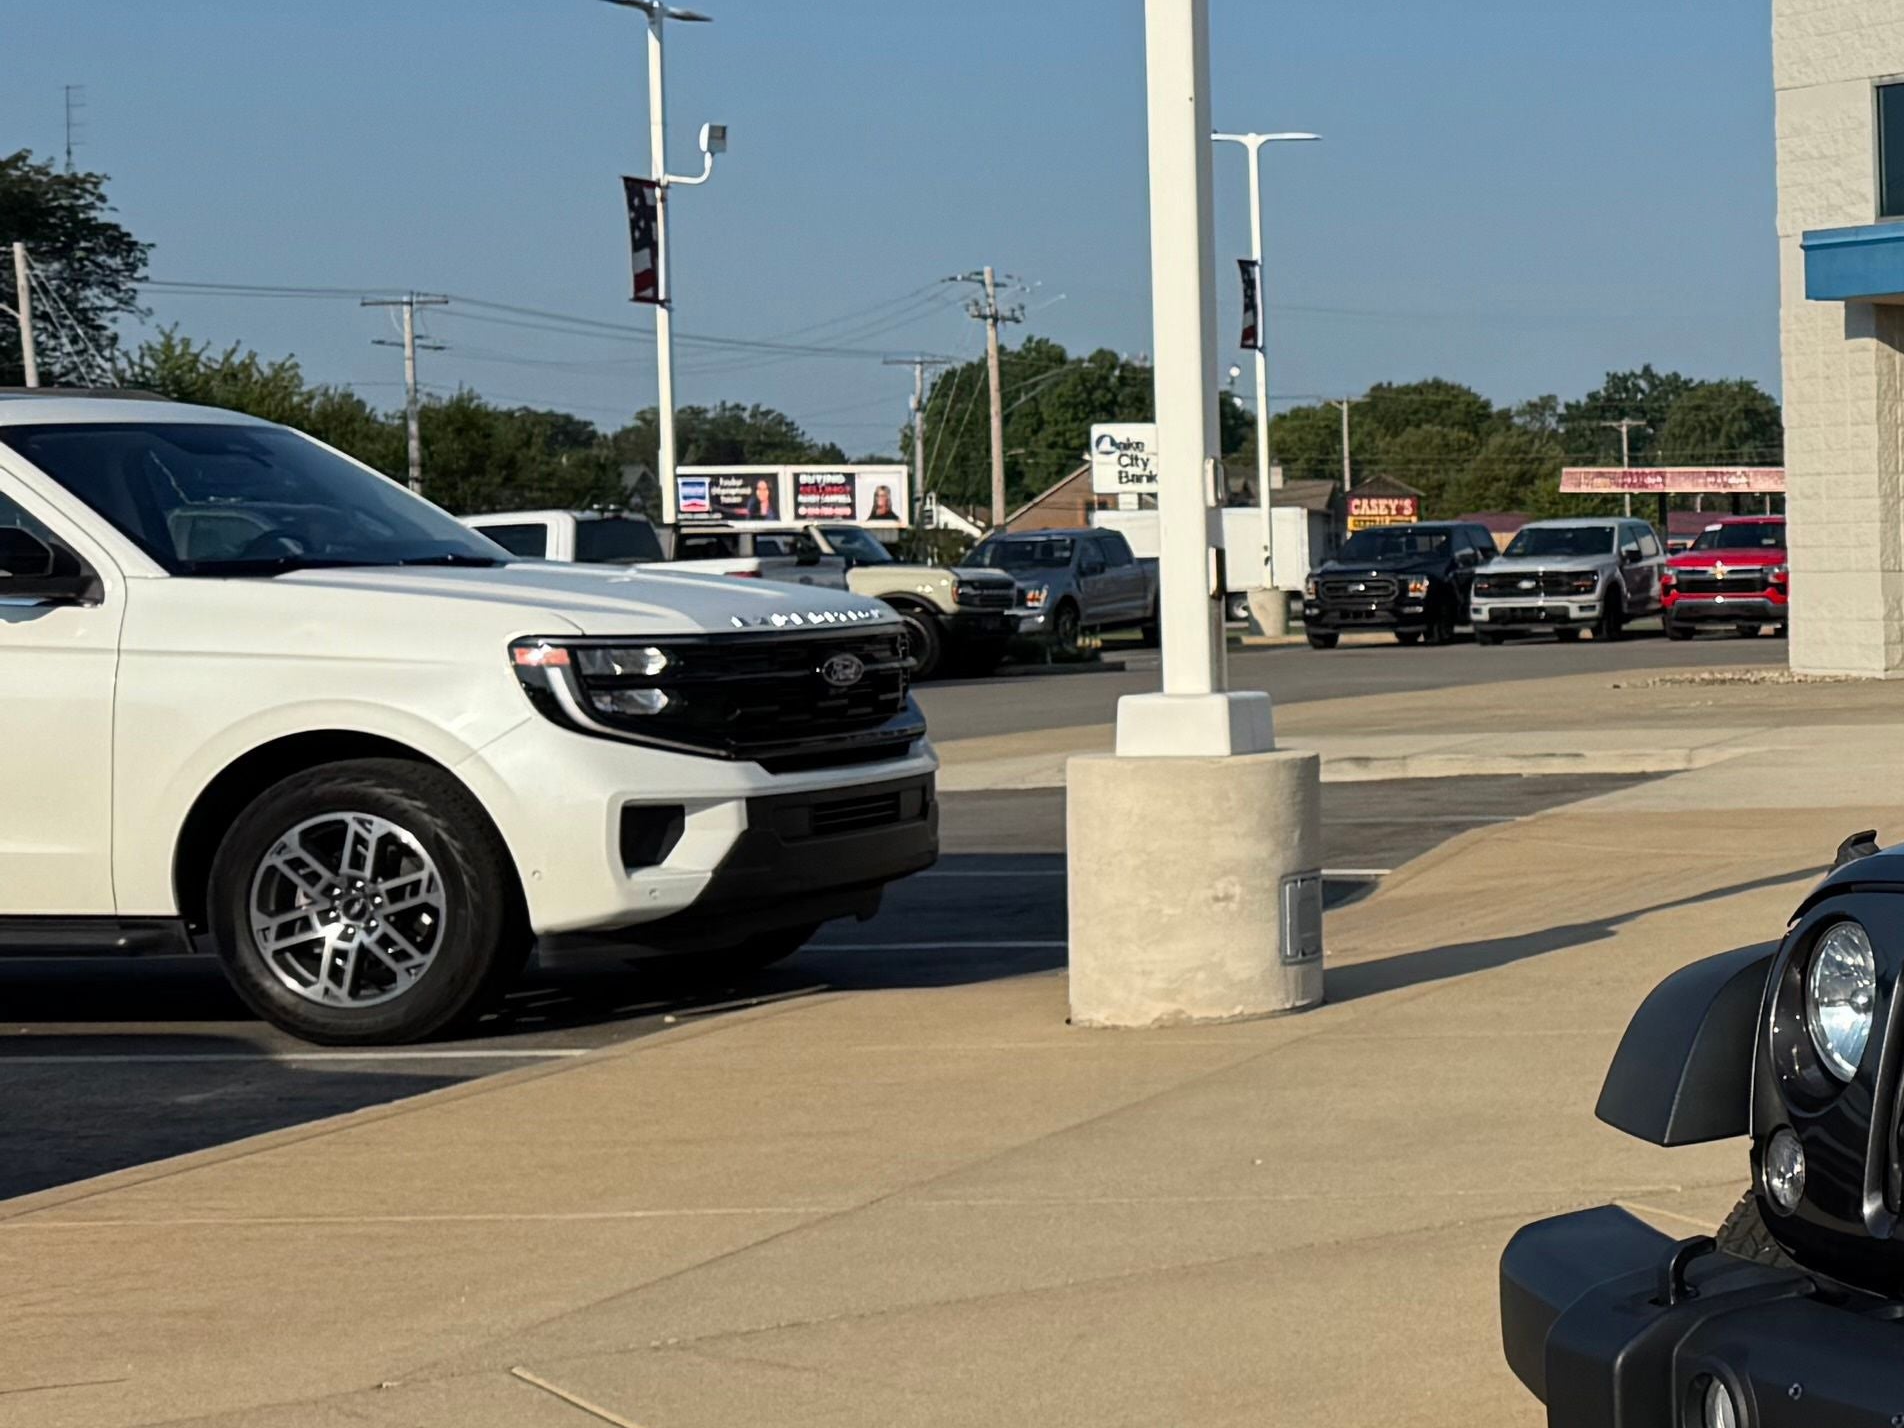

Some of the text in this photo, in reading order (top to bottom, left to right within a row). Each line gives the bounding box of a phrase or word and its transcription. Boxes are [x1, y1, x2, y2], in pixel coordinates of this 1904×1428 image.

[1117, 453, 1150, 472] City
[1118, 470, 1158, 485] Bank
[1351, 498, 1413, 515] CASEY'S
